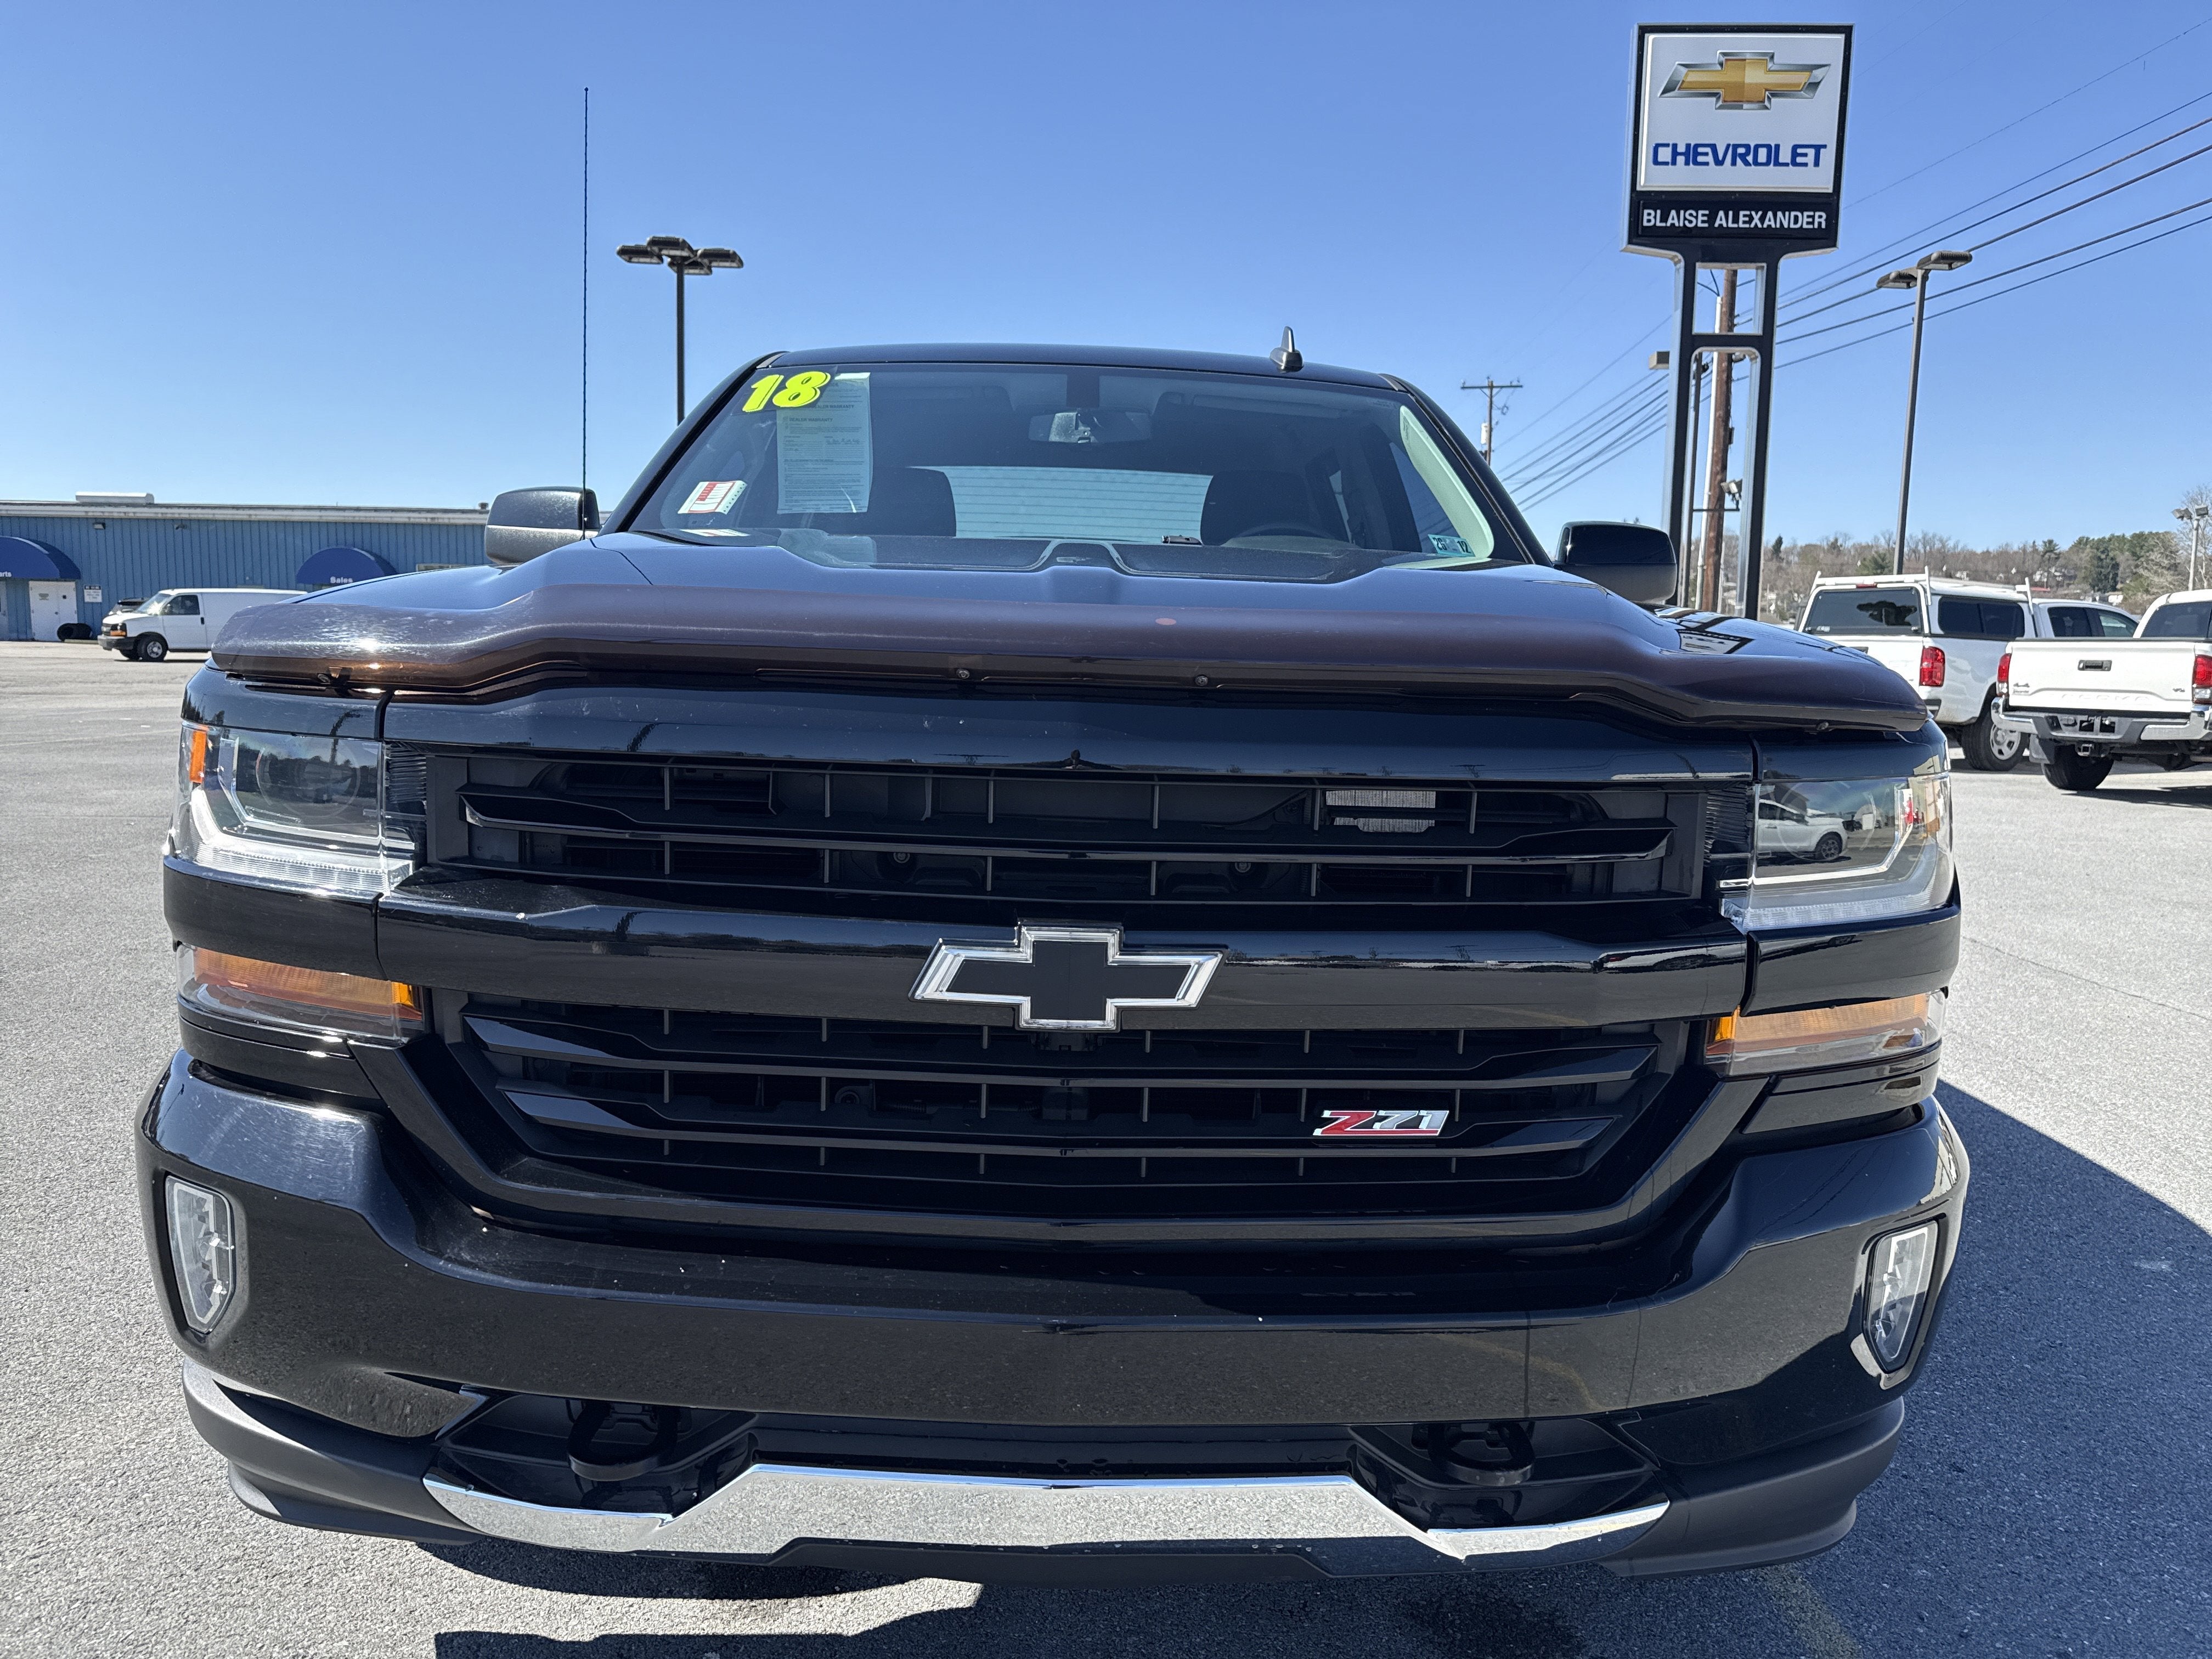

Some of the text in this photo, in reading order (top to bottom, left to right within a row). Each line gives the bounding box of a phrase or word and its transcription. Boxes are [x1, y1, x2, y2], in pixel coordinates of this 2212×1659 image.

[1652, 143, 1827, 168] CHEVROLET
[1643, 209, 1827, 229] BLAISE ALEXANDER
[742, 371, 831, 413] 18
[1457, 540, 1471, 554] 12
[1312, 1110, 1449, 1136] Z71
